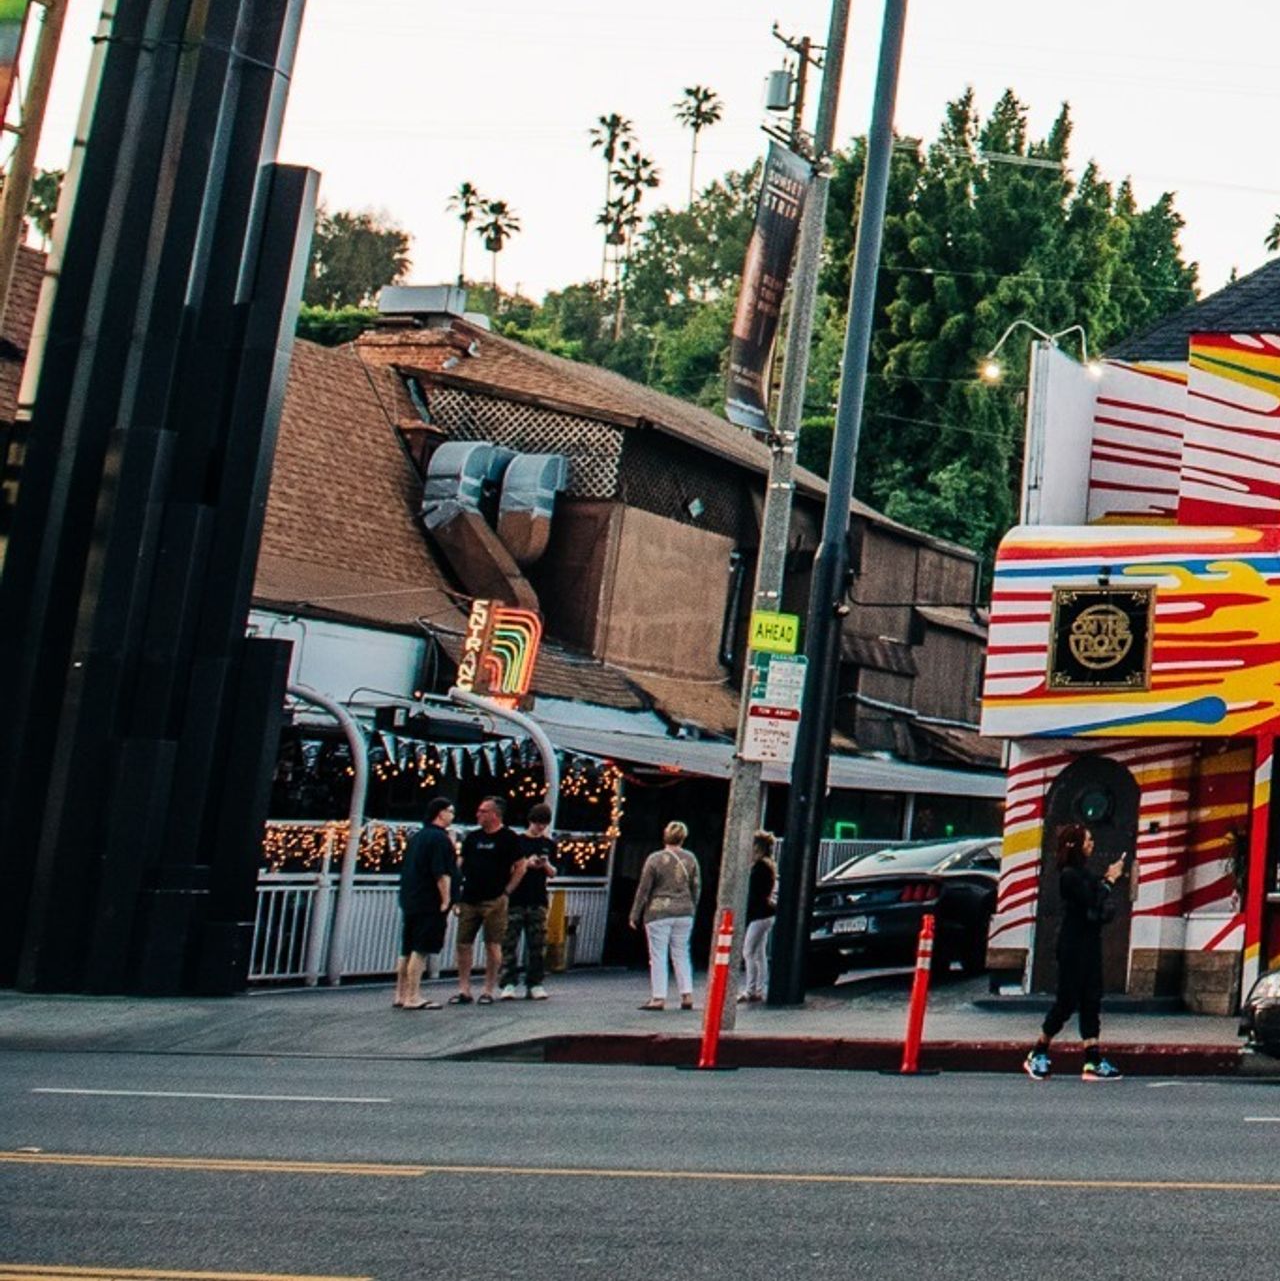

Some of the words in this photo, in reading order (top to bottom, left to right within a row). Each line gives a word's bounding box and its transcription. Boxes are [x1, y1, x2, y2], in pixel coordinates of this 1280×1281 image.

[768, 169, 805, 198] SUNSET
[763, 192, 798, 220] STRIP
[455, 599, 490, 693] ENTRANC
[756, 622, 794, 643] AHEAD
